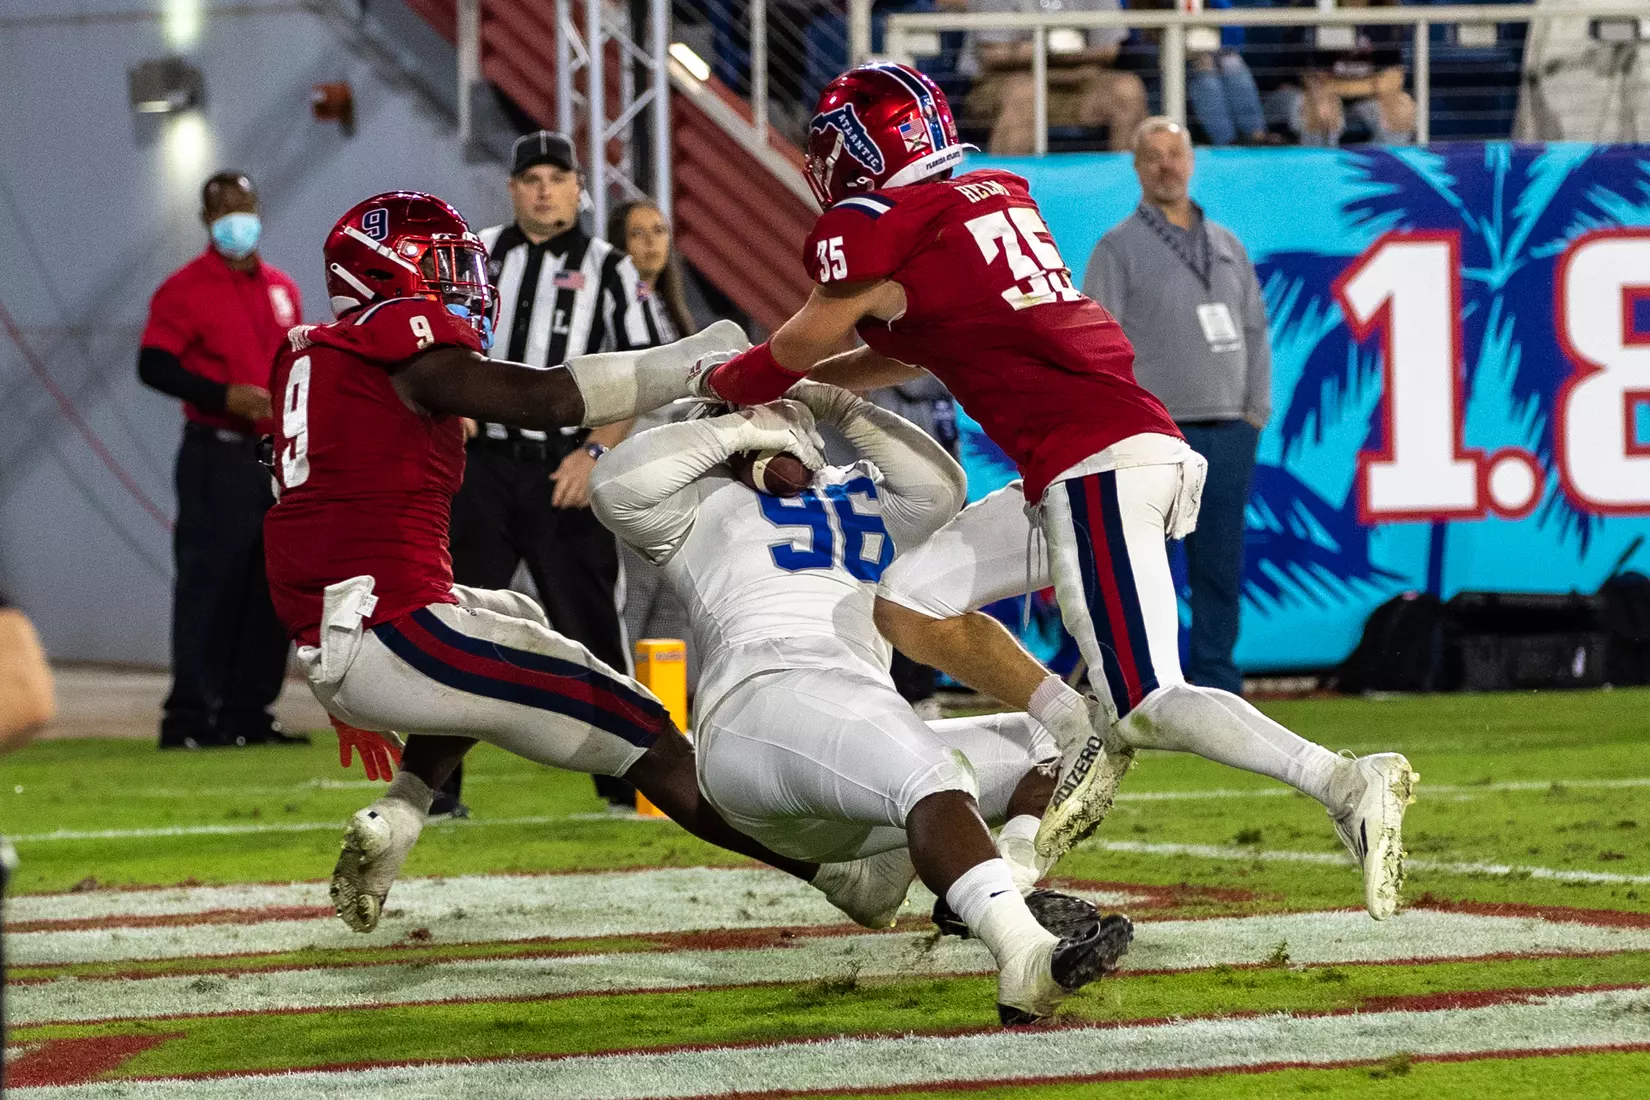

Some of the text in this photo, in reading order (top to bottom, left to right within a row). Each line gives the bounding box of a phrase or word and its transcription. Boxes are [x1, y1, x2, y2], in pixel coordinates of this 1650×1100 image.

[838, 114, 880, 167] ATLANTIC
[926, 156, 946, 170] FLORIDA
[954, 180, 1011, 203] HELM
[362, 208, 389, 242] 9
[816, 236, 848, 283] 35
[964, 207, 1081, 311] 35
[409, 315, 434, 350] 9
[282, 355, 311, 489] 9
[756, 476, 897, 584] 96
